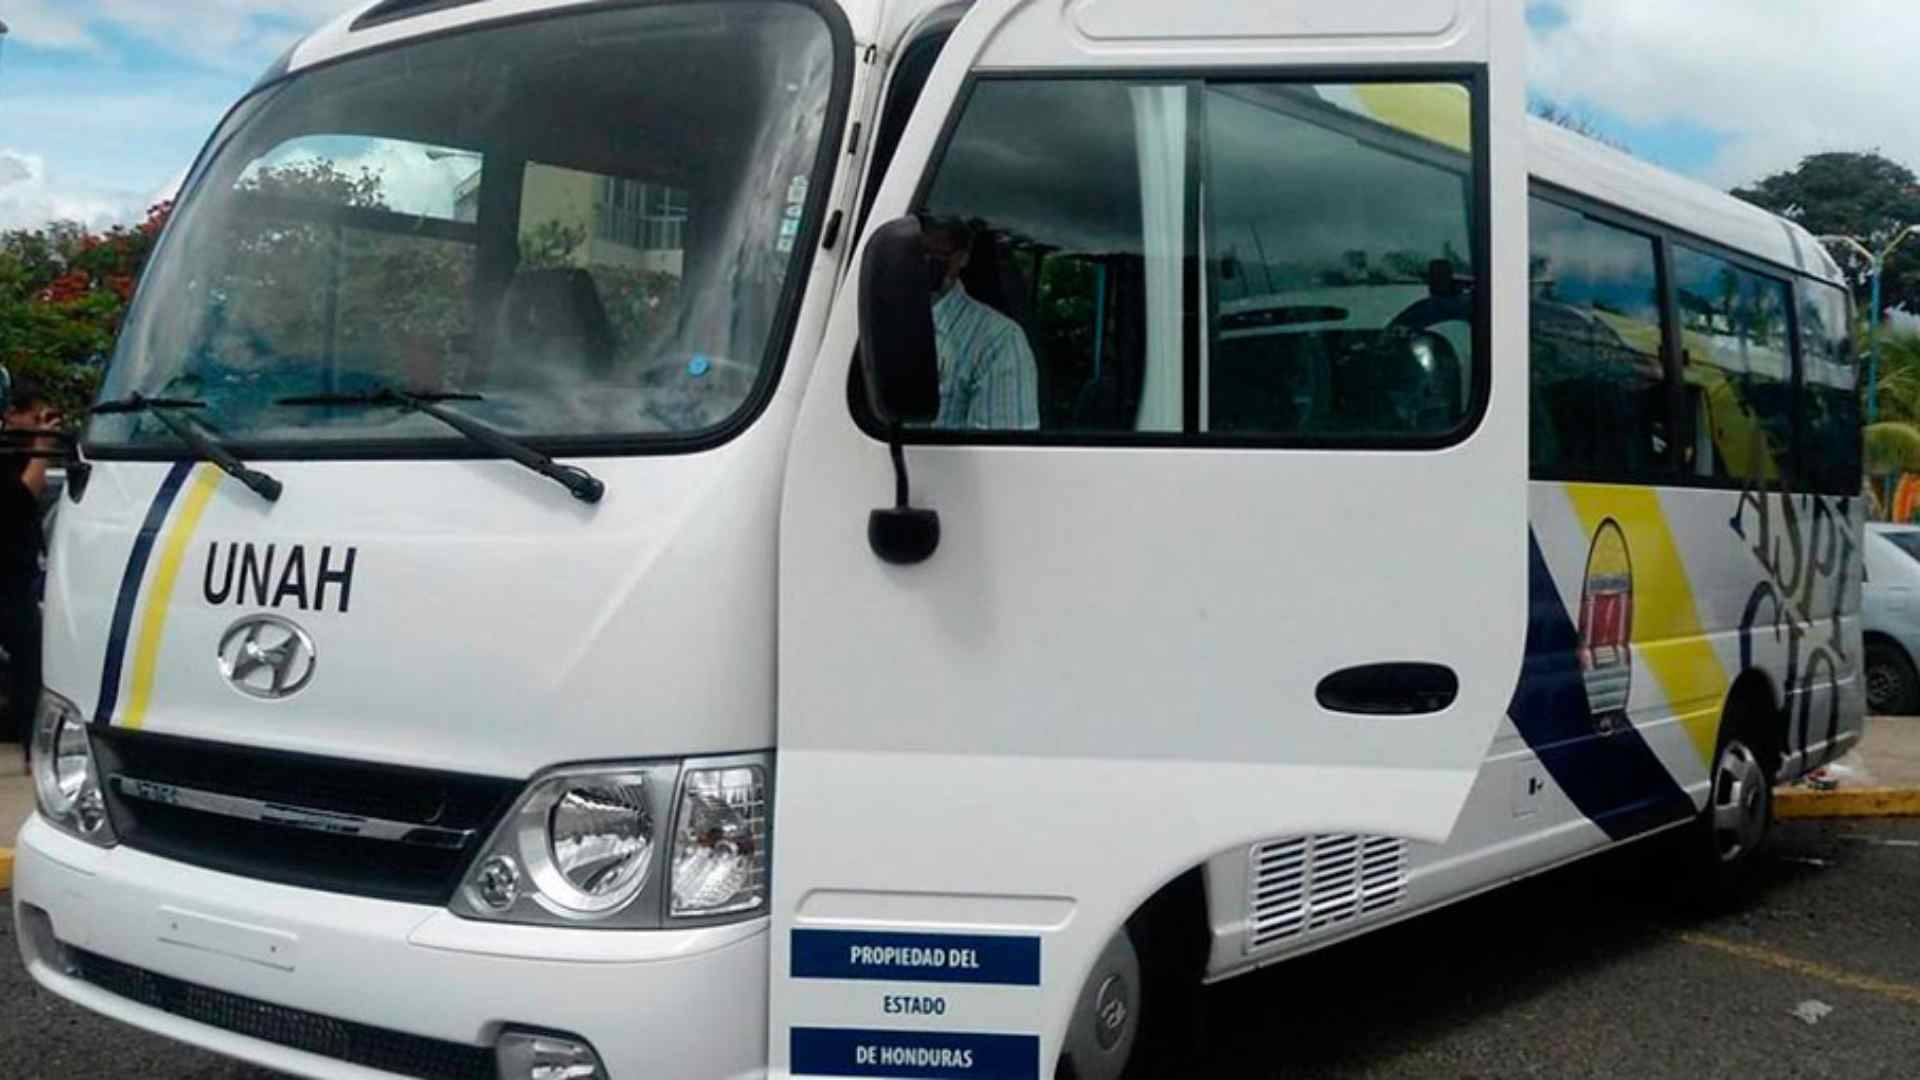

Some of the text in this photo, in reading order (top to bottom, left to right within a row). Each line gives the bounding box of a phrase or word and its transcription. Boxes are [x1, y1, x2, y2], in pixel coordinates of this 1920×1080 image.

[203, 541, 357, 613] UNAH
[850, 945, 980, 969] PROPIEDAD DEL
[883, 995, 946, 1016] ESTADO
[856, 1046, 974, 1069] DE HONDURAS
